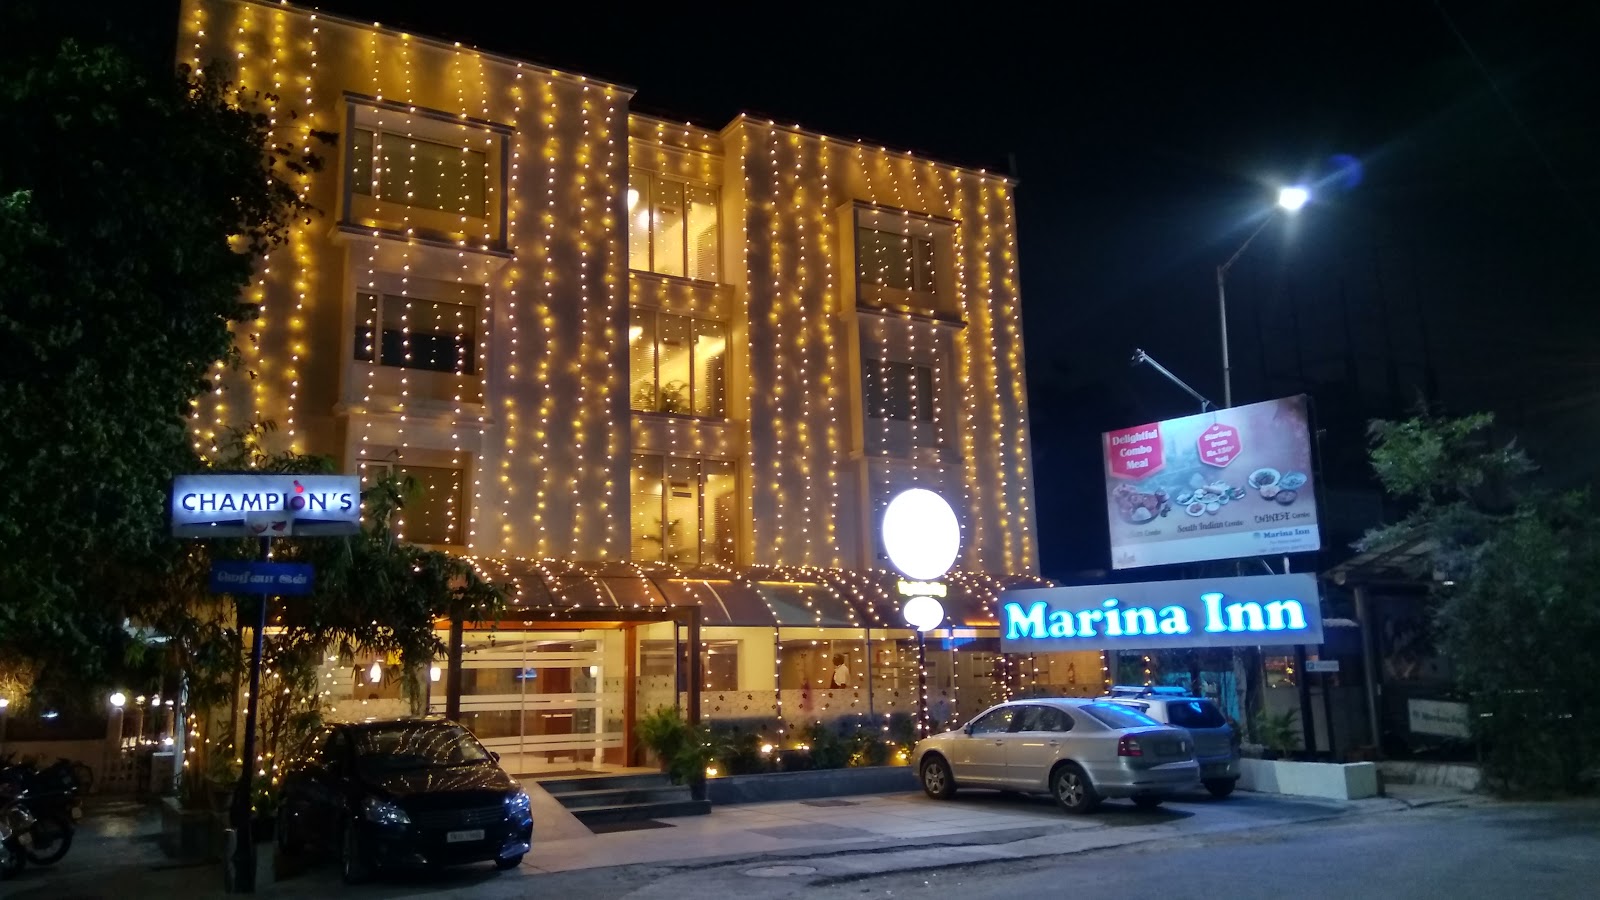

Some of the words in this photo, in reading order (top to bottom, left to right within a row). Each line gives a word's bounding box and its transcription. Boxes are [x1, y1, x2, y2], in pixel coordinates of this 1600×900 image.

[1112, 429, 1158, 445] Delightful
[1204, 430, 1232, 441] Starting
[1120, 445, 1152, 457] Combo
[1126, 458, 1149, 470] Meal
[182, 492, 352, 511] CHAMPION'S
[1254, 511, 1290, 523] CHINESE
[1177, 524, 1198, 533] South
[1199, 521, 1223, 530] Indian
[1224, 519, 1244, 528] Combo
[1263, 530, 1293, 538] Marina
[1004, 598, 1191, 639] Marina
[1200, 592, 1307, 633] Inn
